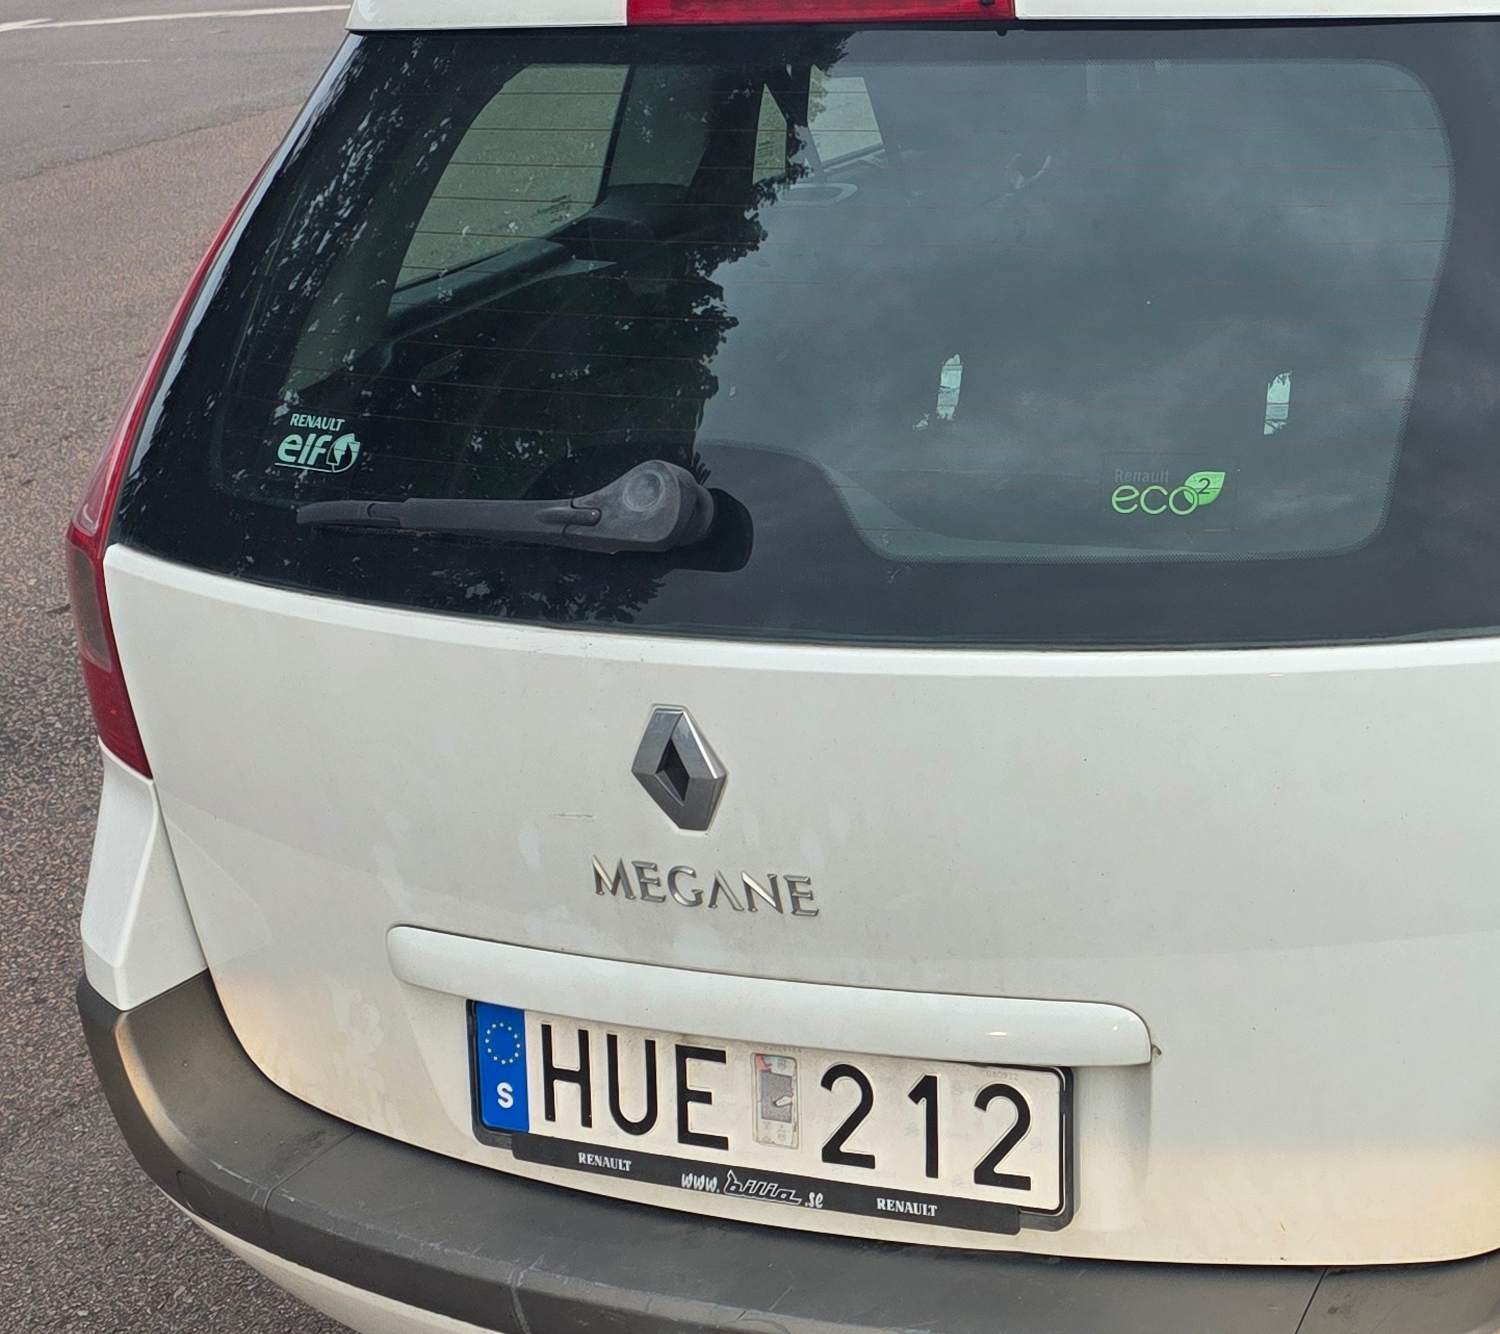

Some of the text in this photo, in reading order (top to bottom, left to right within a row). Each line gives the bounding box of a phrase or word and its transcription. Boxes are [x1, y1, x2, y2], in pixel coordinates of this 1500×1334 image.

[289, 413, 346, 432] RENAULT
[277, 433, 333, 466] elf
[1114, 468, 1170, 483] Renault
[590, 854, 820, 917] MEGANE
[496, 1082, 514, 1109] S
[541, 1023, 1034, 1192] HUE 212
[578, 1152, 632, 1172] RENAULT
[876, 1197, 938, 1217] RENAULT
